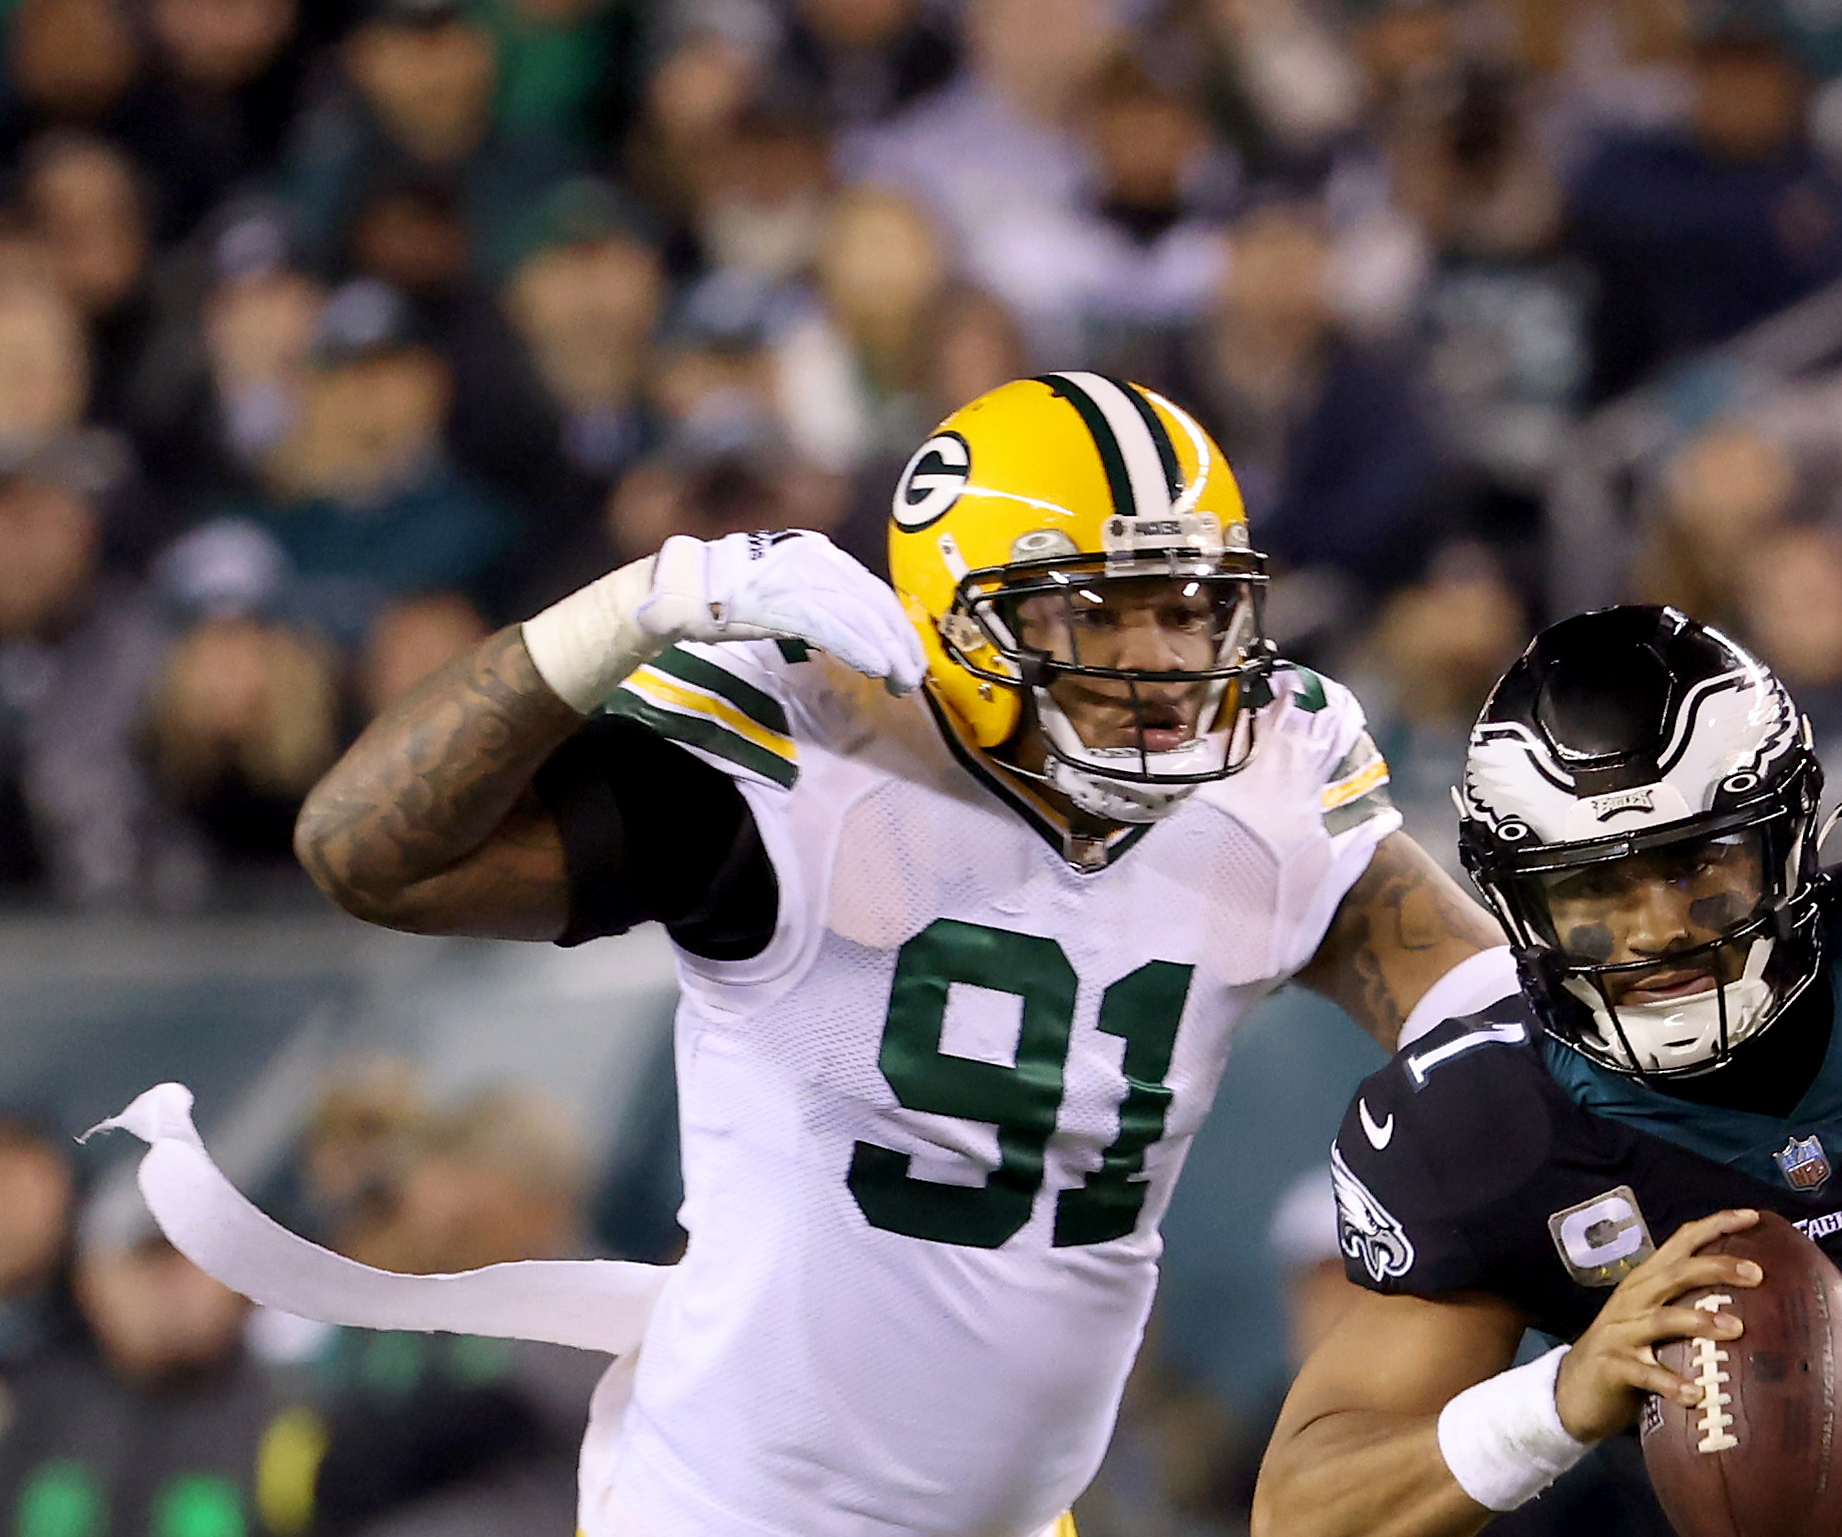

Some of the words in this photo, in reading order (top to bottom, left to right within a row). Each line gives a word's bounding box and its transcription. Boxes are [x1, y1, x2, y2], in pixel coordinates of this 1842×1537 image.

[891, 431, 971, 533] G
[846, 917, 1196, 1250] 91
[1407, 1022, 1526, 1084] 1
[1561, 1197, 1641, 1269] C
